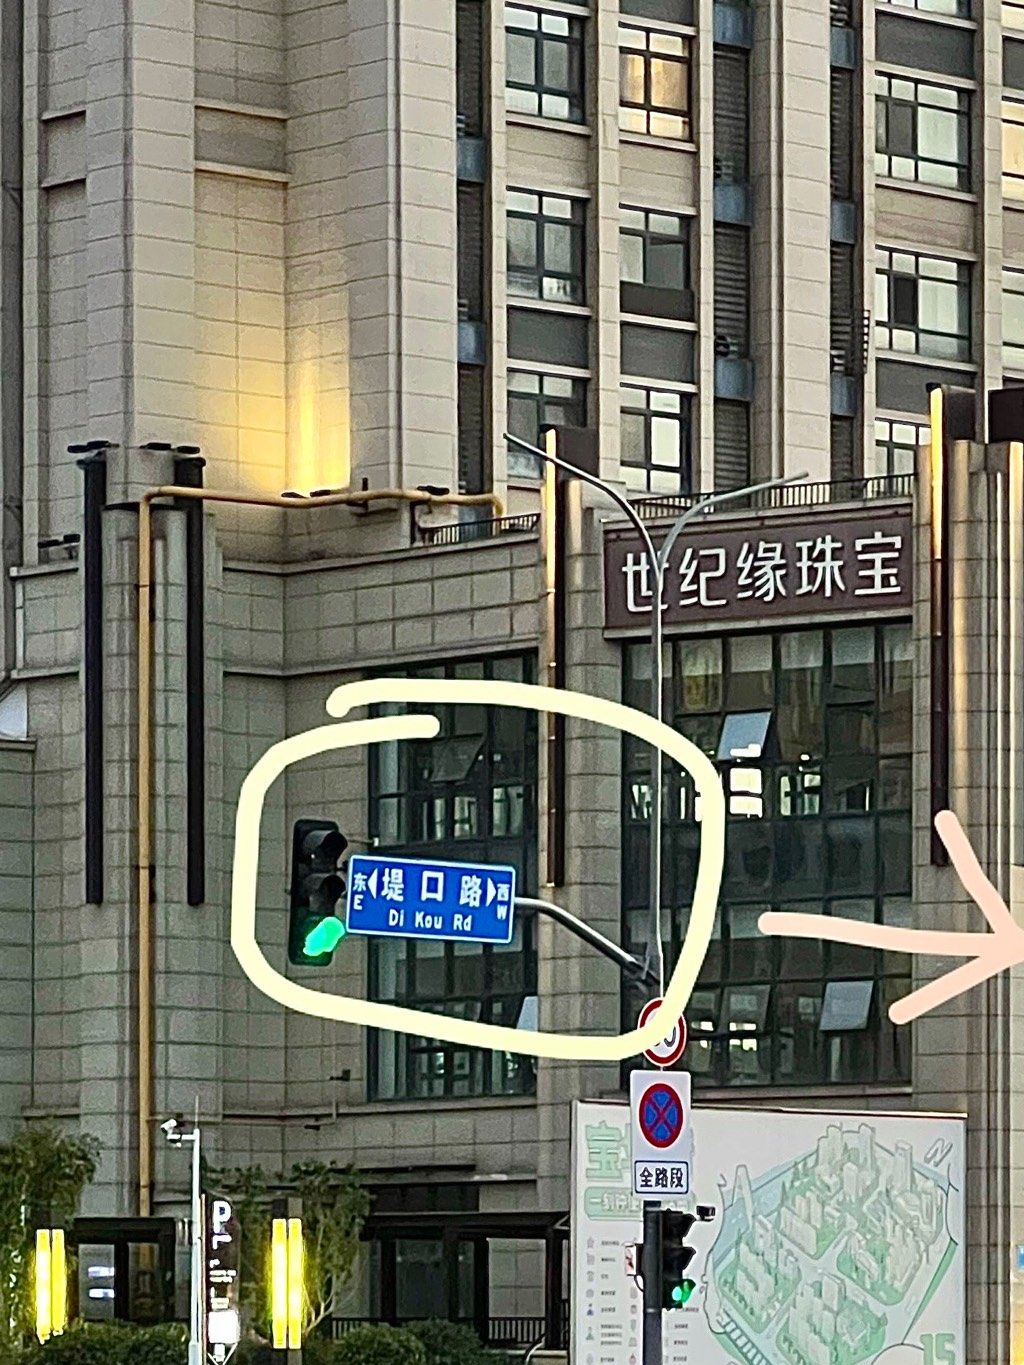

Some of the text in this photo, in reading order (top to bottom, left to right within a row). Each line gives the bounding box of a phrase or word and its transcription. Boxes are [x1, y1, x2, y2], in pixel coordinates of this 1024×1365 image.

[622, 532, 902, 613] 世纪缘珠宝
[352, 872, 367, 892] 东
[380, 867, 482, 908] 堤口路
[497, 883, 510, 901] 西
[353, 895, 364, 910] E
[496, 905, 508, 920] W
[388, 908, 473, 932] Di Kou Rd
[639, 1166, 684, 1188] 全路段
[213, 1200, 232, 1234] P
